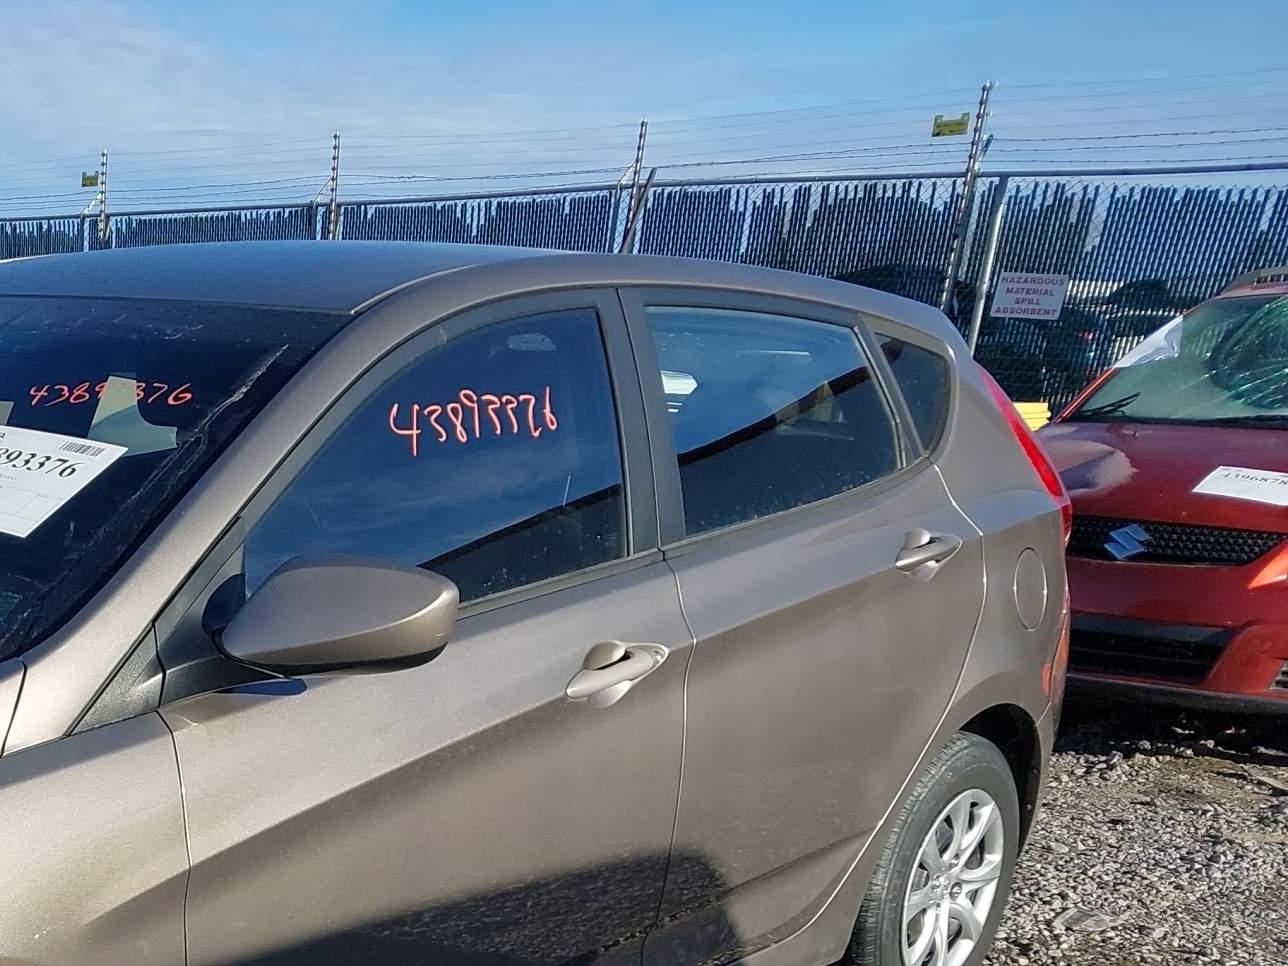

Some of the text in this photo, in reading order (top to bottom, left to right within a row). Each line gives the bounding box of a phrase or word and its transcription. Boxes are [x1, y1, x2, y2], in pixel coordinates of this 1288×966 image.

[1001, 276, 1065, 286] HAZARDOUS
[1005, 287, 1055, 296] MATERIAL
[1014, 297, 1041, 305] SPILL
[995, 306, 1057, 316] ABSORBENT
[29, 382, 193, 407] 4389376
